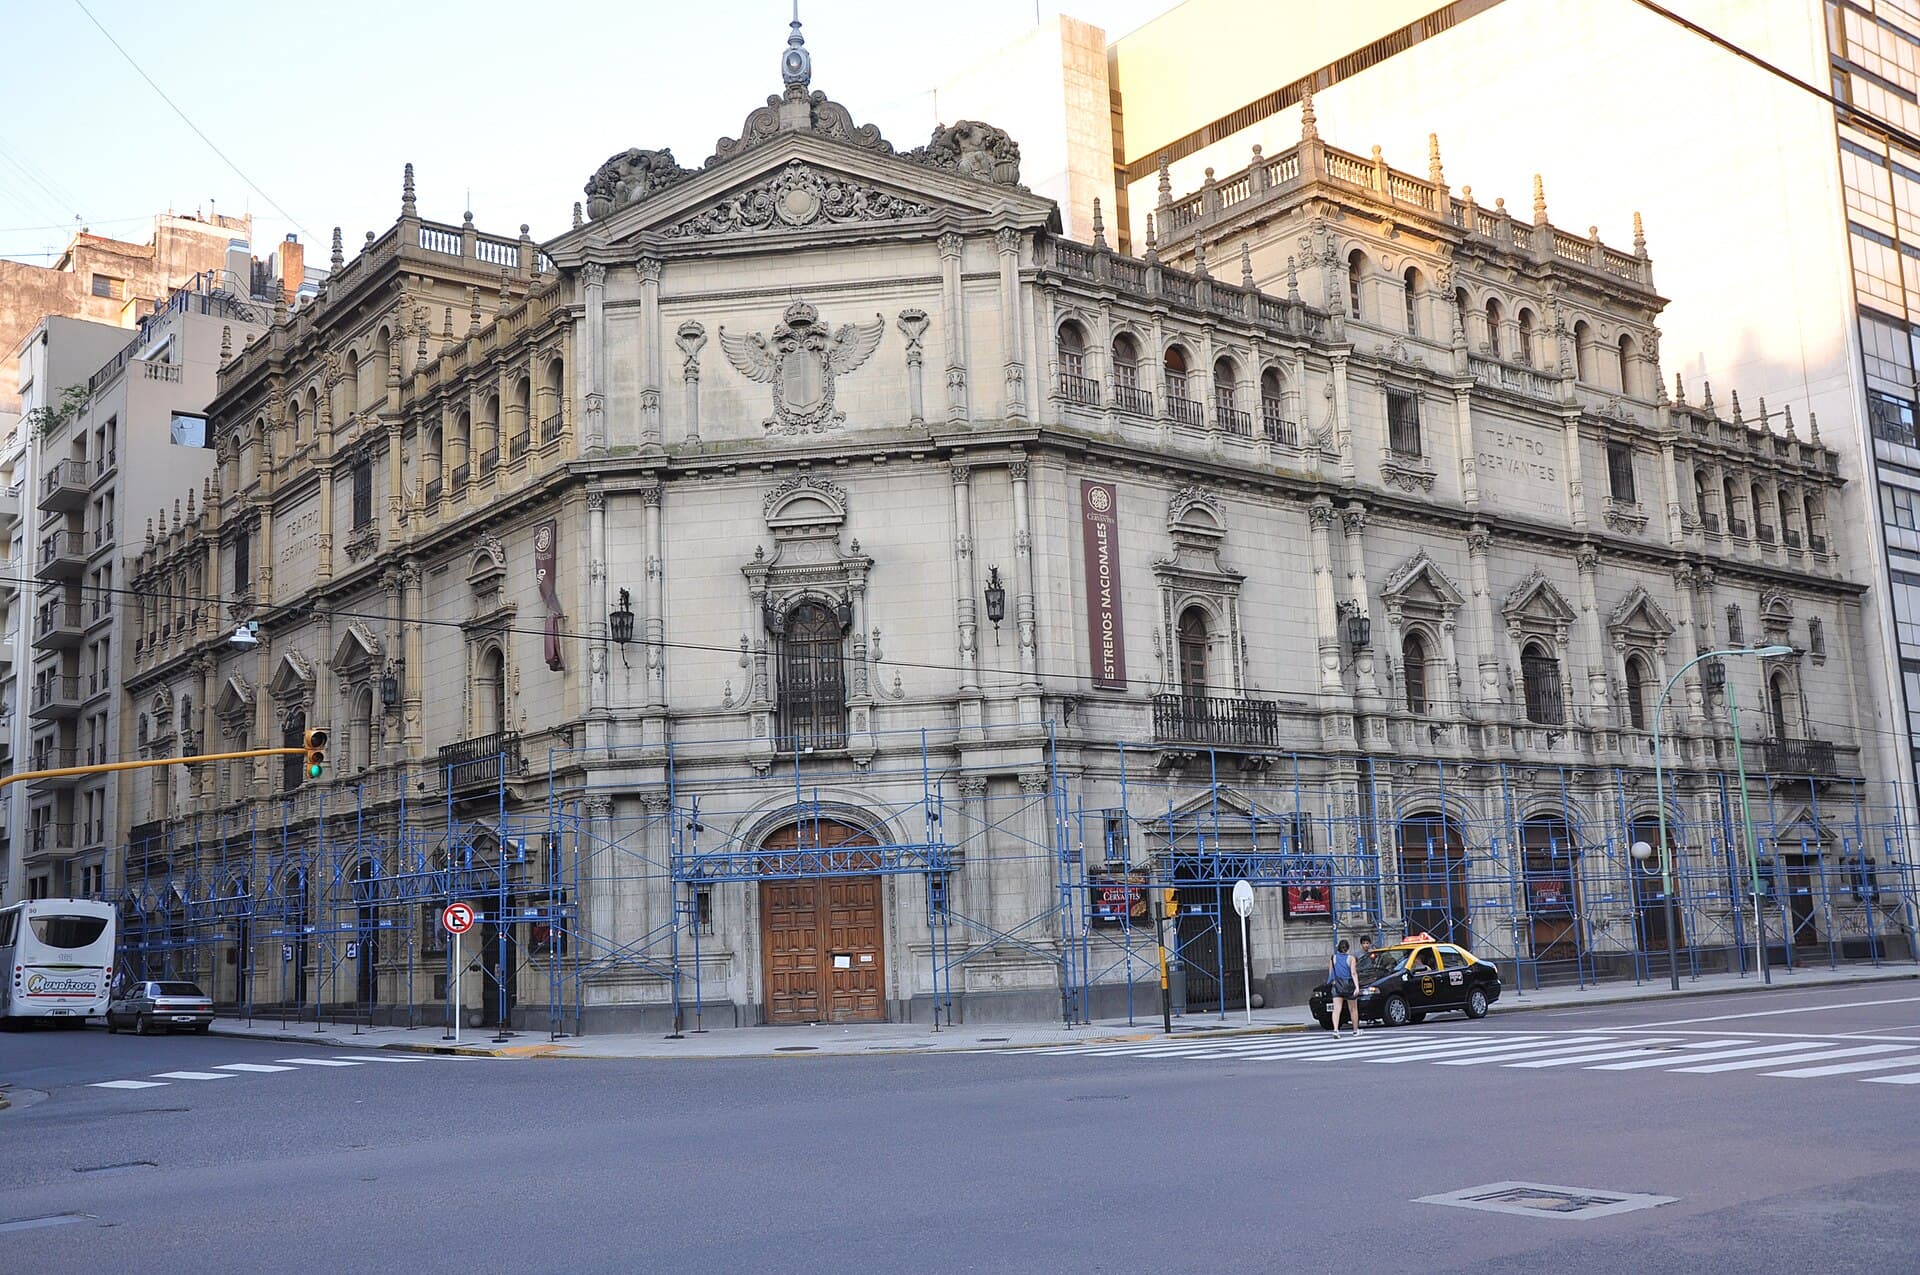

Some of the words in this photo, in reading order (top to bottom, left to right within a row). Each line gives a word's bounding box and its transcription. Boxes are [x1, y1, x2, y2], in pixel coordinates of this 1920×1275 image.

[1486, 429, 1544, 456] TEATRO
[1479, 452, 1555, 481] CERVANTES
[287, 510, 318, 539] TEATRO
[280, 532, 319, 563] CERVANTE
[1097, 522, 1111, 607] NACIONALES
[1101, 611, 1115, 680] ESTRENOS
[1103, 891, 1140, 901] CERVATES
[453, 910, 465, 926] E
